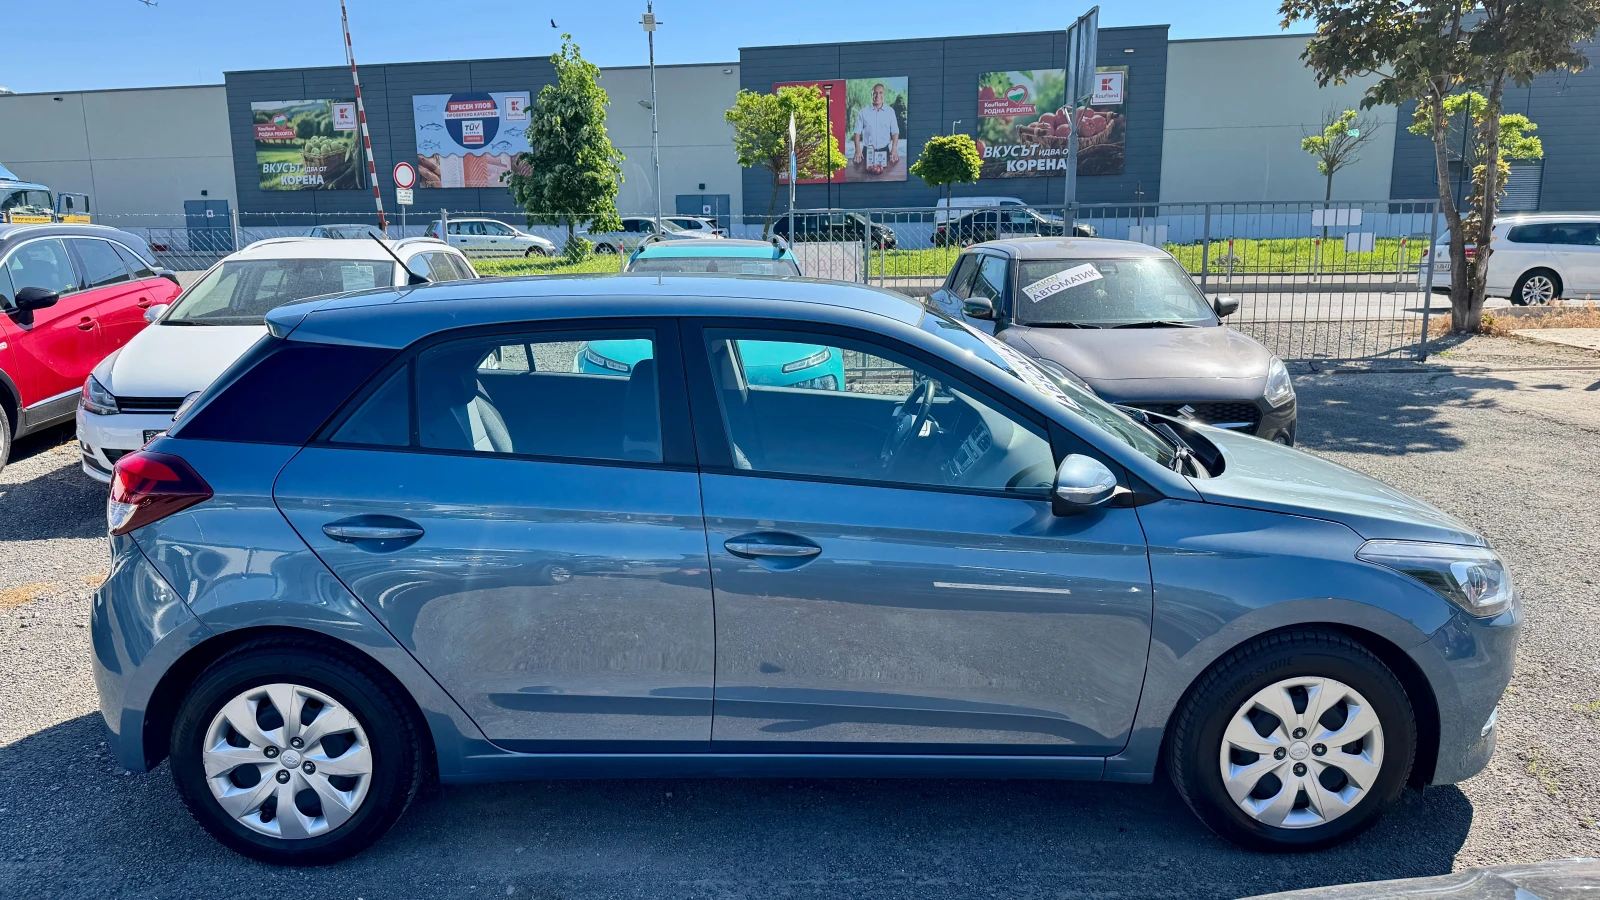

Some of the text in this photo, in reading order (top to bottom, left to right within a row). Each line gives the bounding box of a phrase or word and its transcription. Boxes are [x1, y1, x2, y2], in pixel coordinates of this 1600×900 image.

[450, 103, 473, 111] ПРЕСЕН
[464, 123, 480, 131] TÜV
[983, 144, 1040, 158] ВКУСЪТ
[262, 162, 302, 174] ВКУСЪТ
[1006, 158, 1067, 172] КОРЕНА
[281, 174, 325, 185] КОРЕНА
[1026, 275, 1059, 294] DYAKOV
[1032, 269, 1098, 302] АВТОМАТИК
[1218, 656, 1294, 710] BRIDGESTONE
